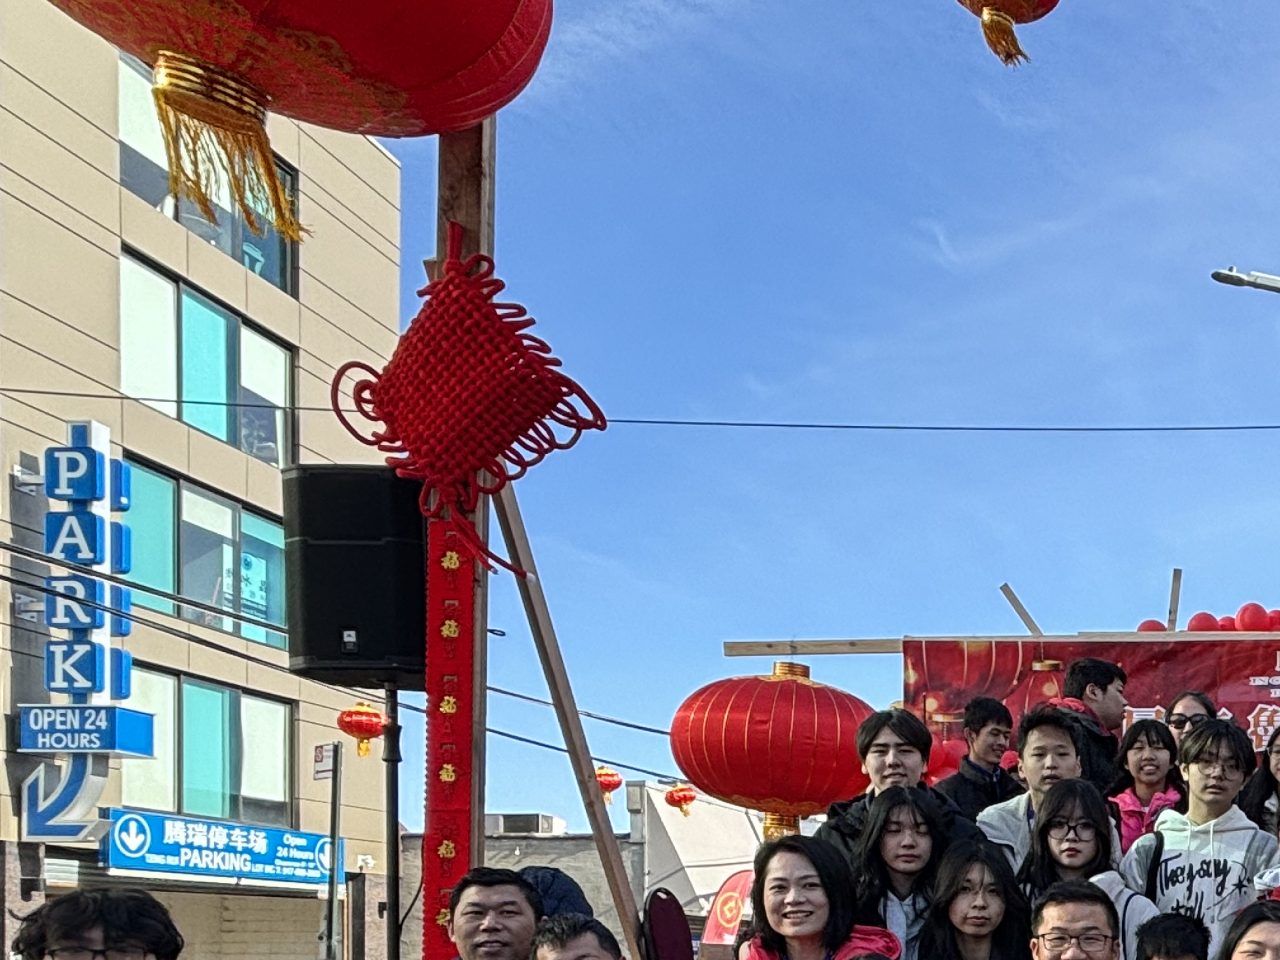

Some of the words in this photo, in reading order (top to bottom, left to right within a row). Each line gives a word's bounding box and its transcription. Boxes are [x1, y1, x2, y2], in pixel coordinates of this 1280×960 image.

[52, 451, 94, 688] PARK
[29, 709, 78, 730] OPEN
[83, 709, 107, 730] 24
[37, 732, 101, 749] HOURS
[180, 848, 251, 872] PARKING
